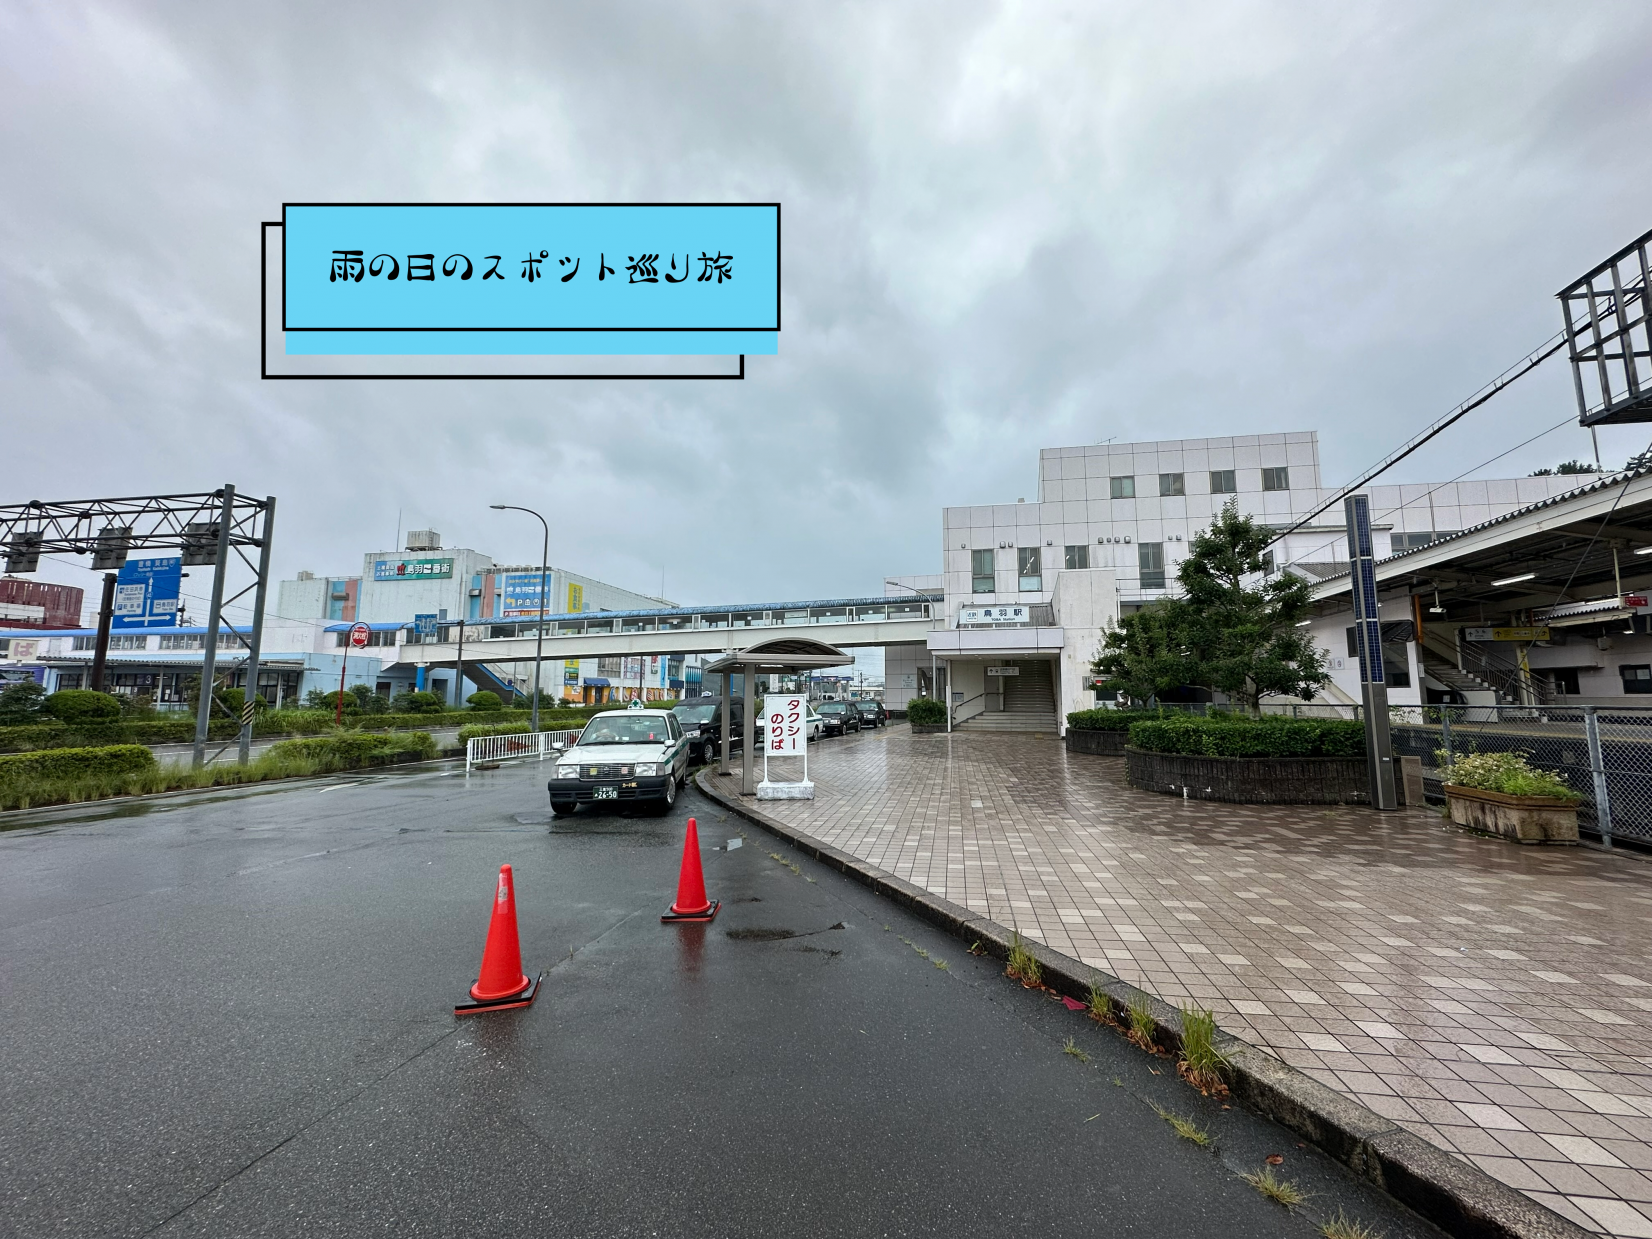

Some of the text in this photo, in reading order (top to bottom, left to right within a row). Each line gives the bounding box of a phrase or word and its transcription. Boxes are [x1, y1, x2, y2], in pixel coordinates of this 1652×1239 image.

[984, 608, 1023, 618] 鳥羽駅
[13, 641, 35, 657] ば
[770, 713, 785, 750] のりば
[787, 699, 800, 750] タクシー
[598, 791, 617, 799] 26-50
